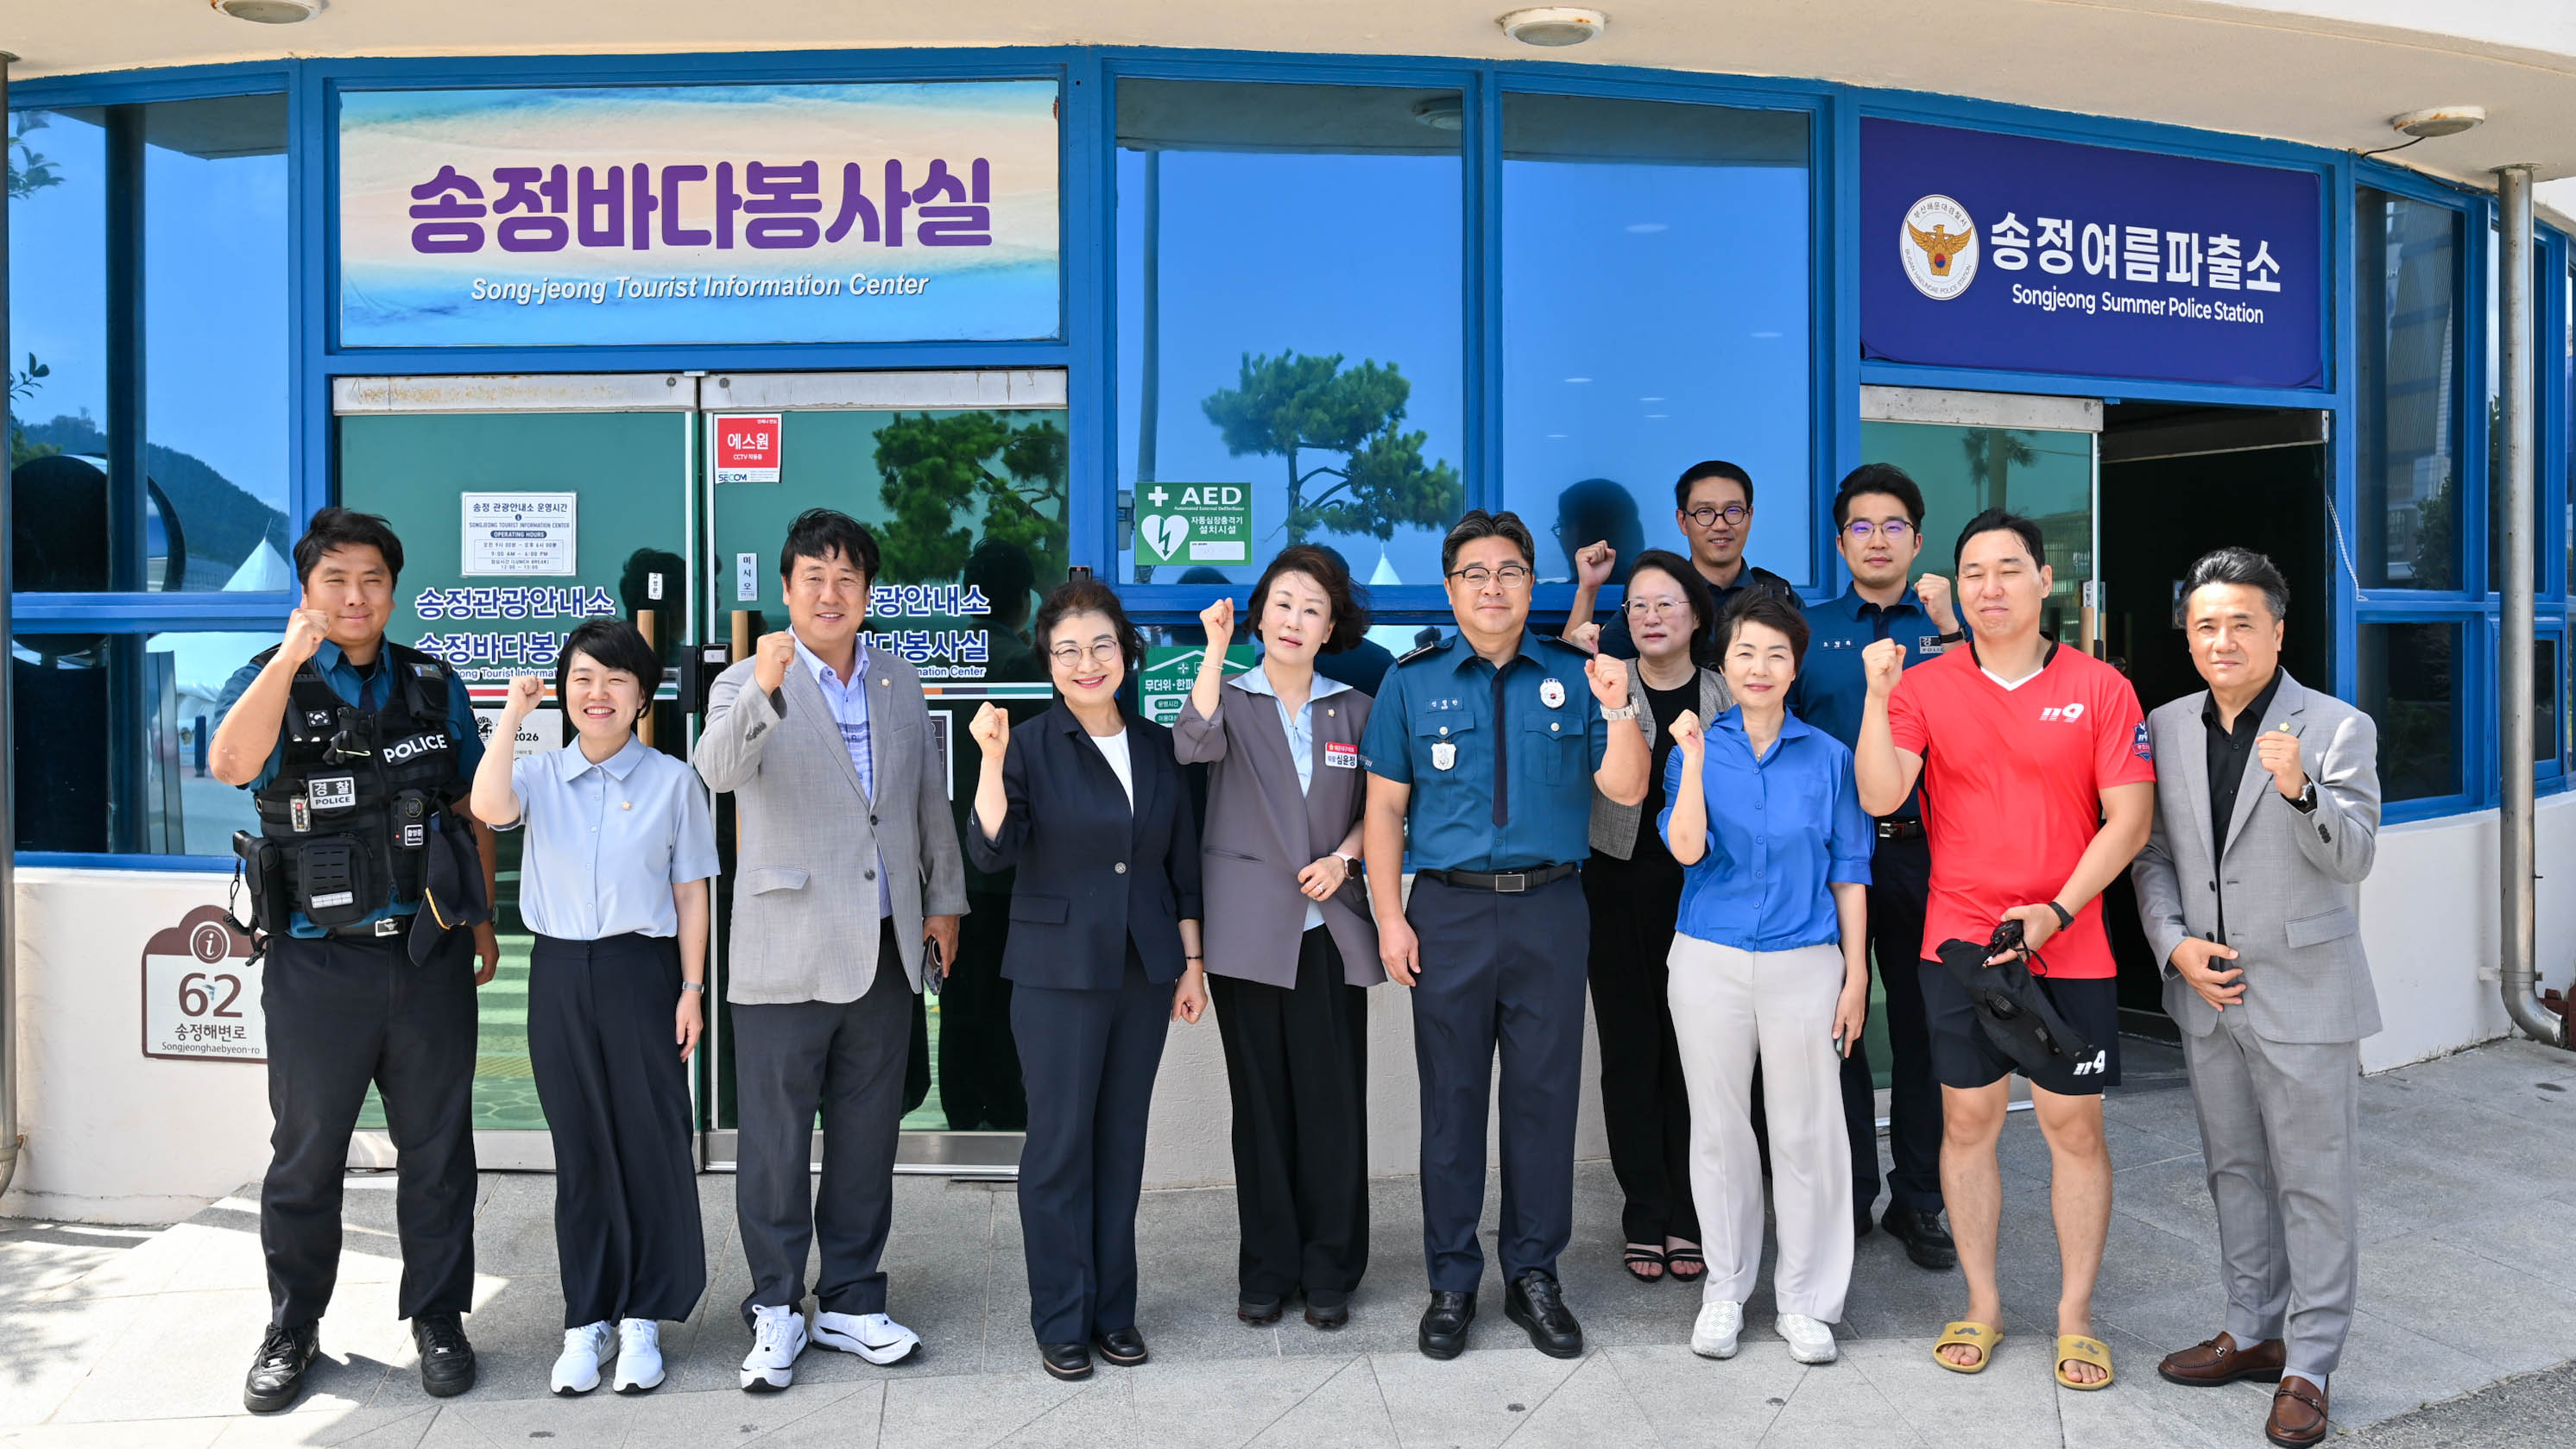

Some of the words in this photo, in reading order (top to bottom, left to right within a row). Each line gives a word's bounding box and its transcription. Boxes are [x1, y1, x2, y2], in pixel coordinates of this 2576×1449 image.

[408, 158, 992, 254] 송정바다봉사실
[1991, 211, 2282, 293] 송정여름파출소
[471, 277, 607, 305] Song-jeong
[615, 275, 698, 299] Tourist
[704, 273, 841, 298] Information
[849, 273, 930, 296] Center
[2012, 283, 2096, 314] Songjeong
[2102, 291, 2167, 316] Summer
[2169, 296, 2212, 321] Police
[2214, 300, 2264, 324] Station
[727, 432, 769, 450] 에스원
[1180, 487, 1242, 505] AED
[473, 502, 490, 513] 송정
[493, 502, 534, 513] 관광안내소
[537, 502, 568, 513] 운영시간
[1190, 516, 1243, 525] 자동심장충격기
[1199, 525, 1236, 534] 설치시설
[415, 586, 616, 620] 송정관광안내소
[414, 632, 570, 665] 송정바다봉
[481, 668, 515, 678] Tourist
[517, 667, 558, 678] Informat
[918, 665, 947, 677] mation
[950, 665, 985, 677] Center
[2039, 702, 2085, 722] 119
[515, 733, 539, 741] 2026
[382, 734, 448, 763] POLICE
[315, 796, 351, 806] POLICE
[178, 973, 243, 1017] 62
[174, 1024, 247, 1043] 송정해변로
[161, 1042, 260, 1055] Songjeonghaebyeon-ro
[2073, 1049, 2106, 1075] 119
